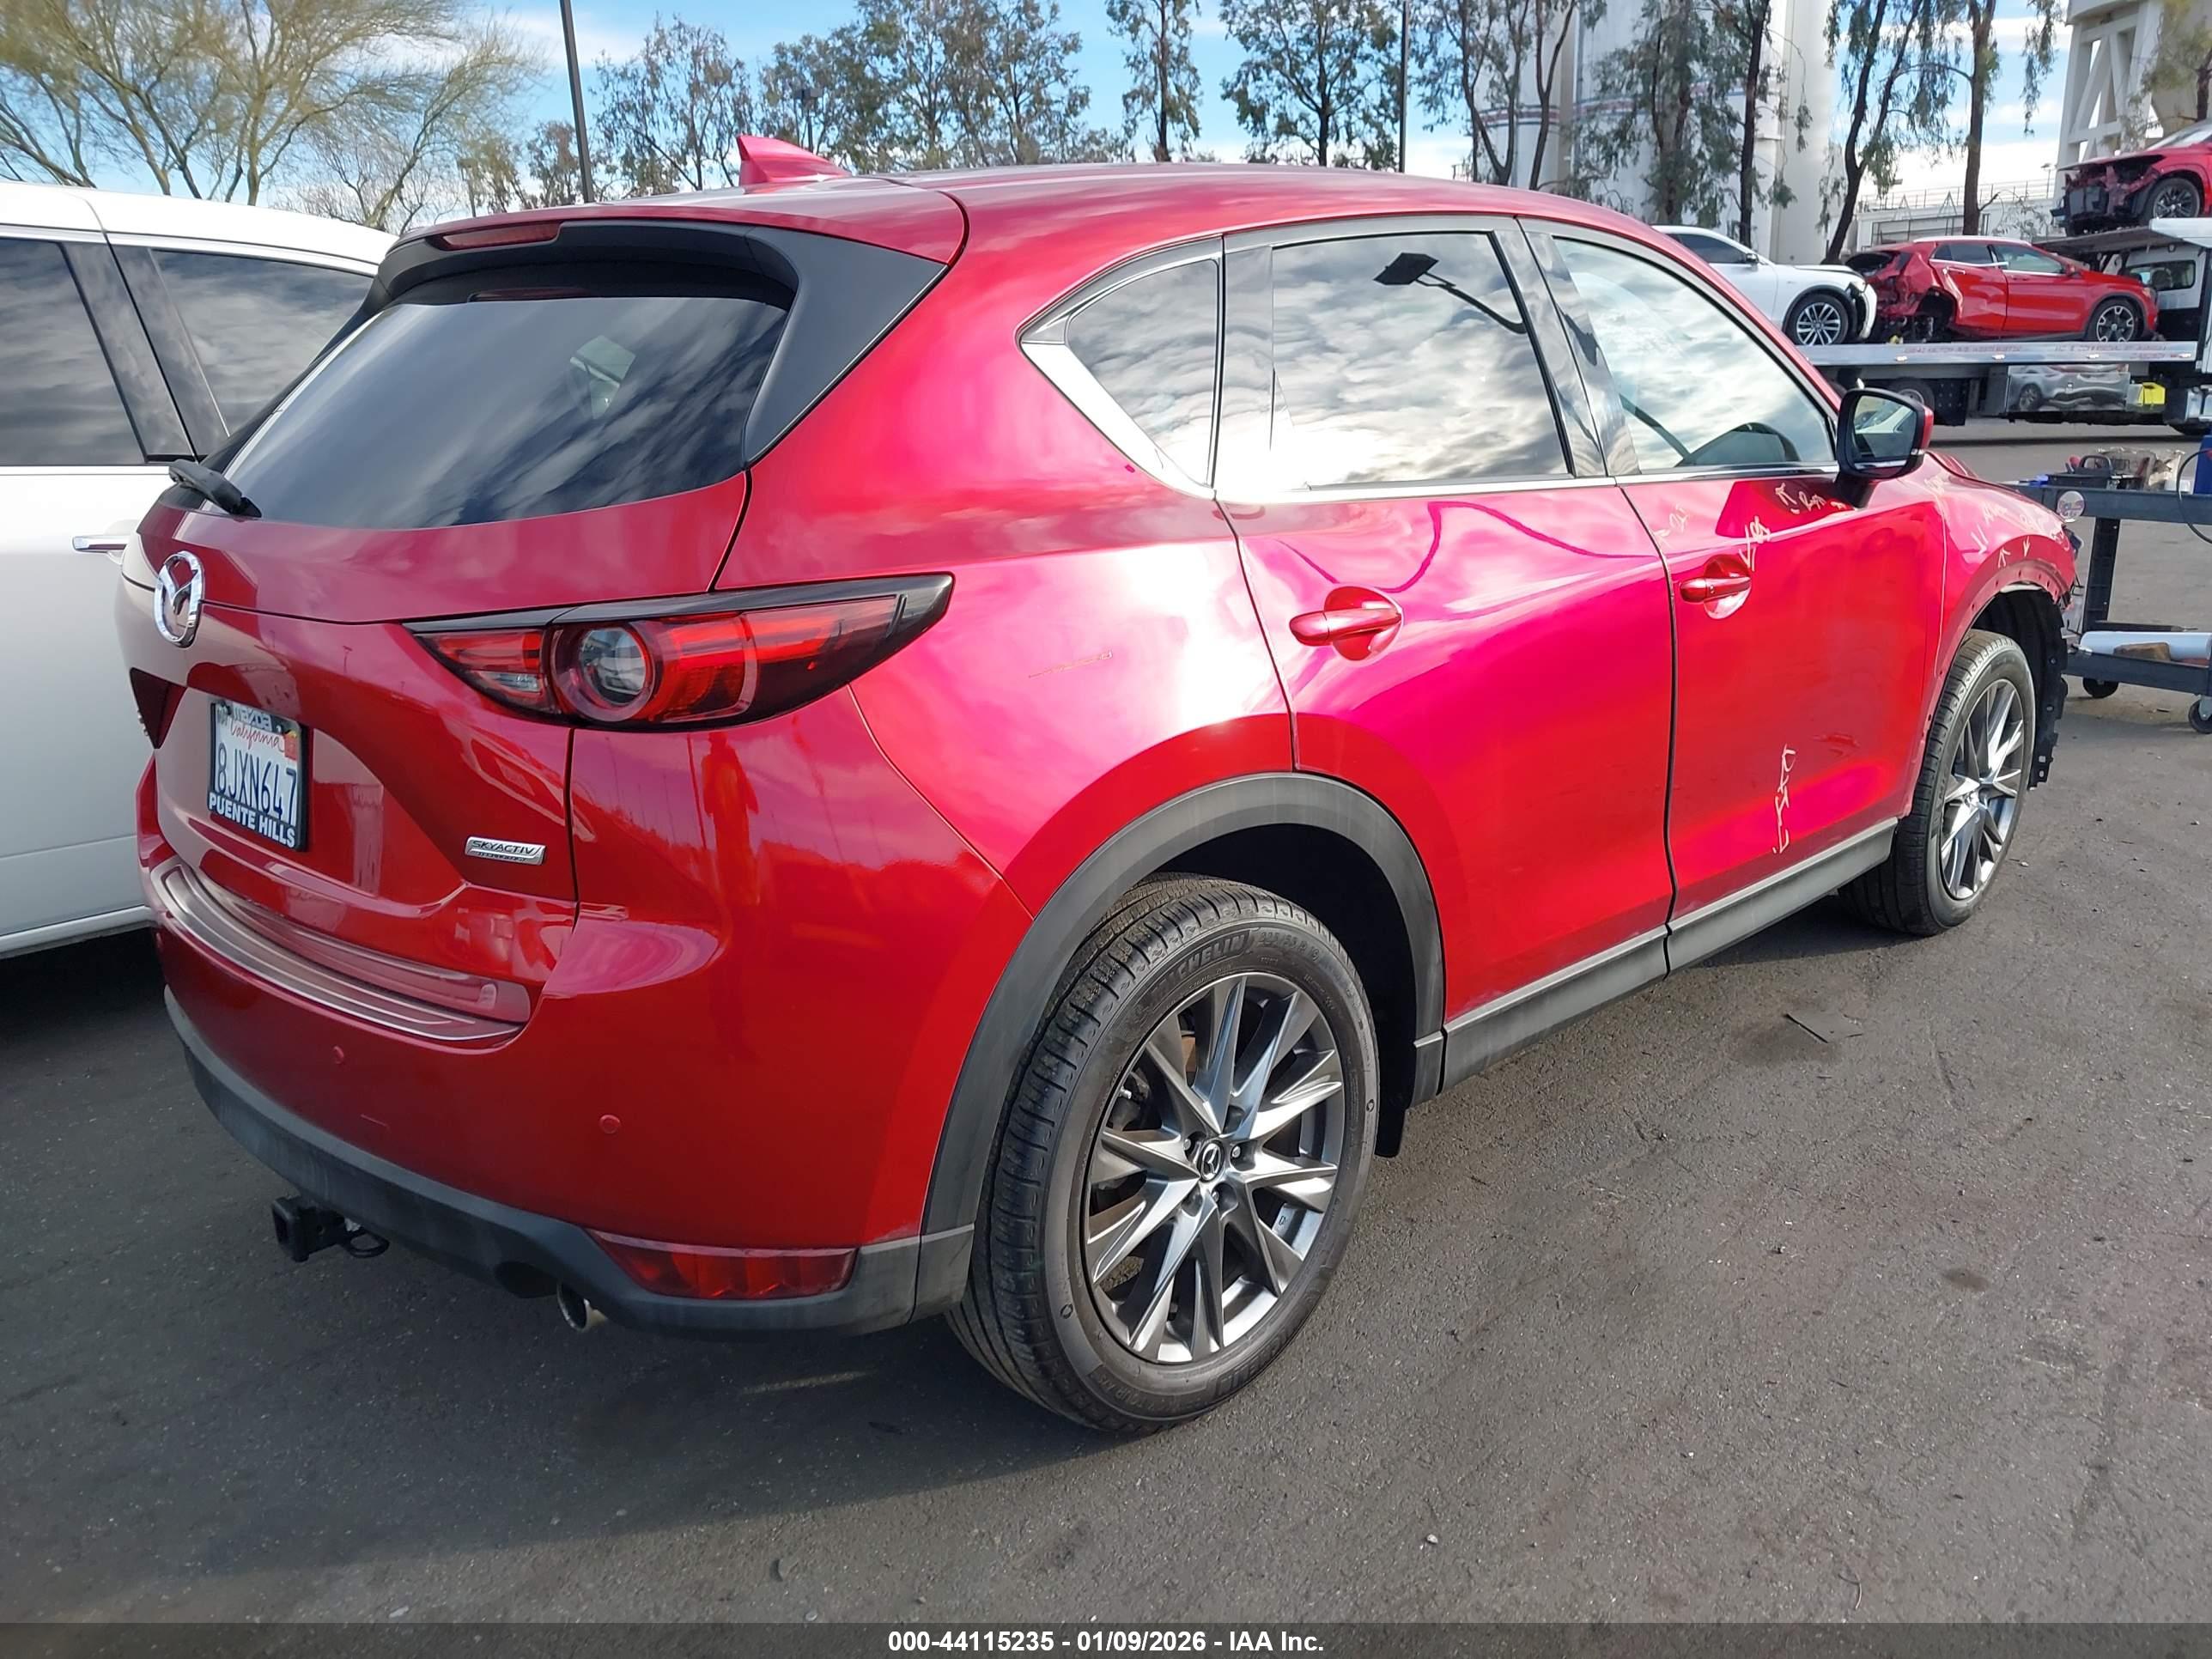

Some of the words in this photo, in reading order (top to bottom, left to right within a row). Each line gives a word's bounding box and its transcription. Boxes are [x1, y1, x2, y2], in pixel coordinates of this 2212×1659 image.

[229, 718, 285, 752] California
[217, 743, 297, 826] 8JXN647
[209, 793, 256, 830] PUENTE
[258, 816, 296, 848] HILLS
[471, 840, 534, 855] SKYACTIV
